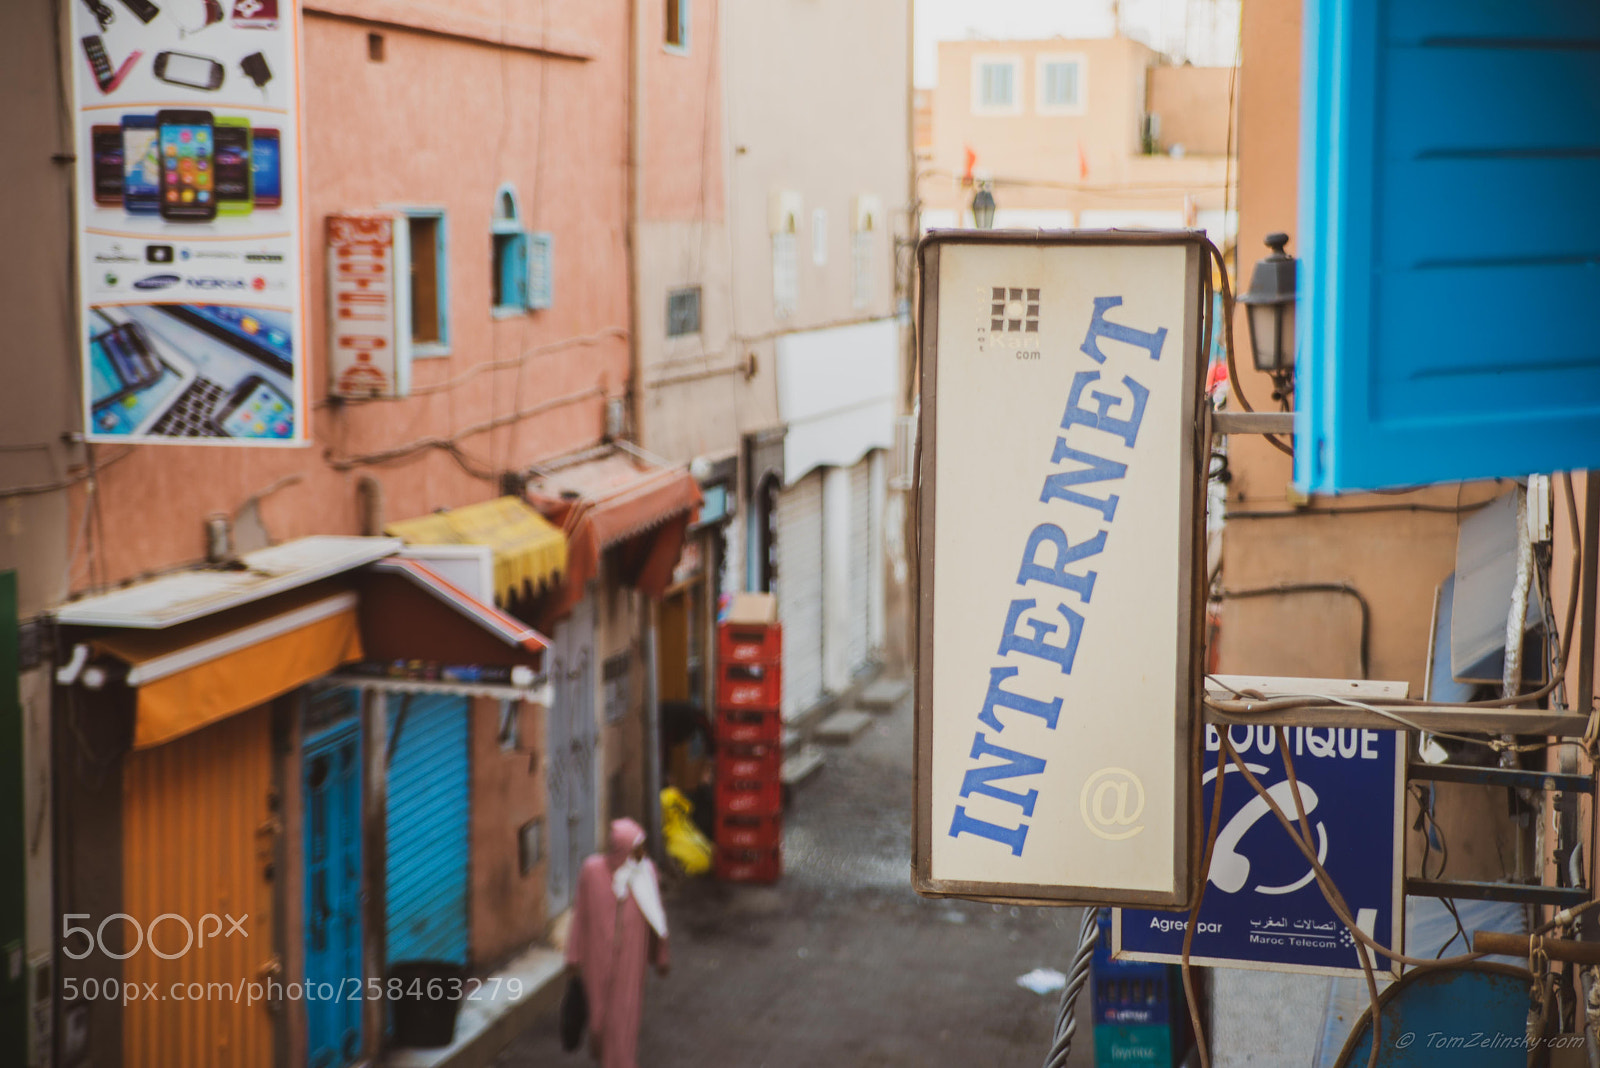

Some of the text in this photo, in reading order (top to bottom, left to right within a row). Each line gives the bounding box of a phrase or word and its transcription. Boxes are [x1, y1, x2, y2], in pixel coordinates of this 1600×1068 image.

[1016, 350, 1041, 360] com
[947, 296, 1168, 857] INTERNET
[1197, 922, 1223, 934] par
[1250, 916, 1337, 931] اتصالات المغرب
[1249, 934, 1337, 949] Maroc Telecom
